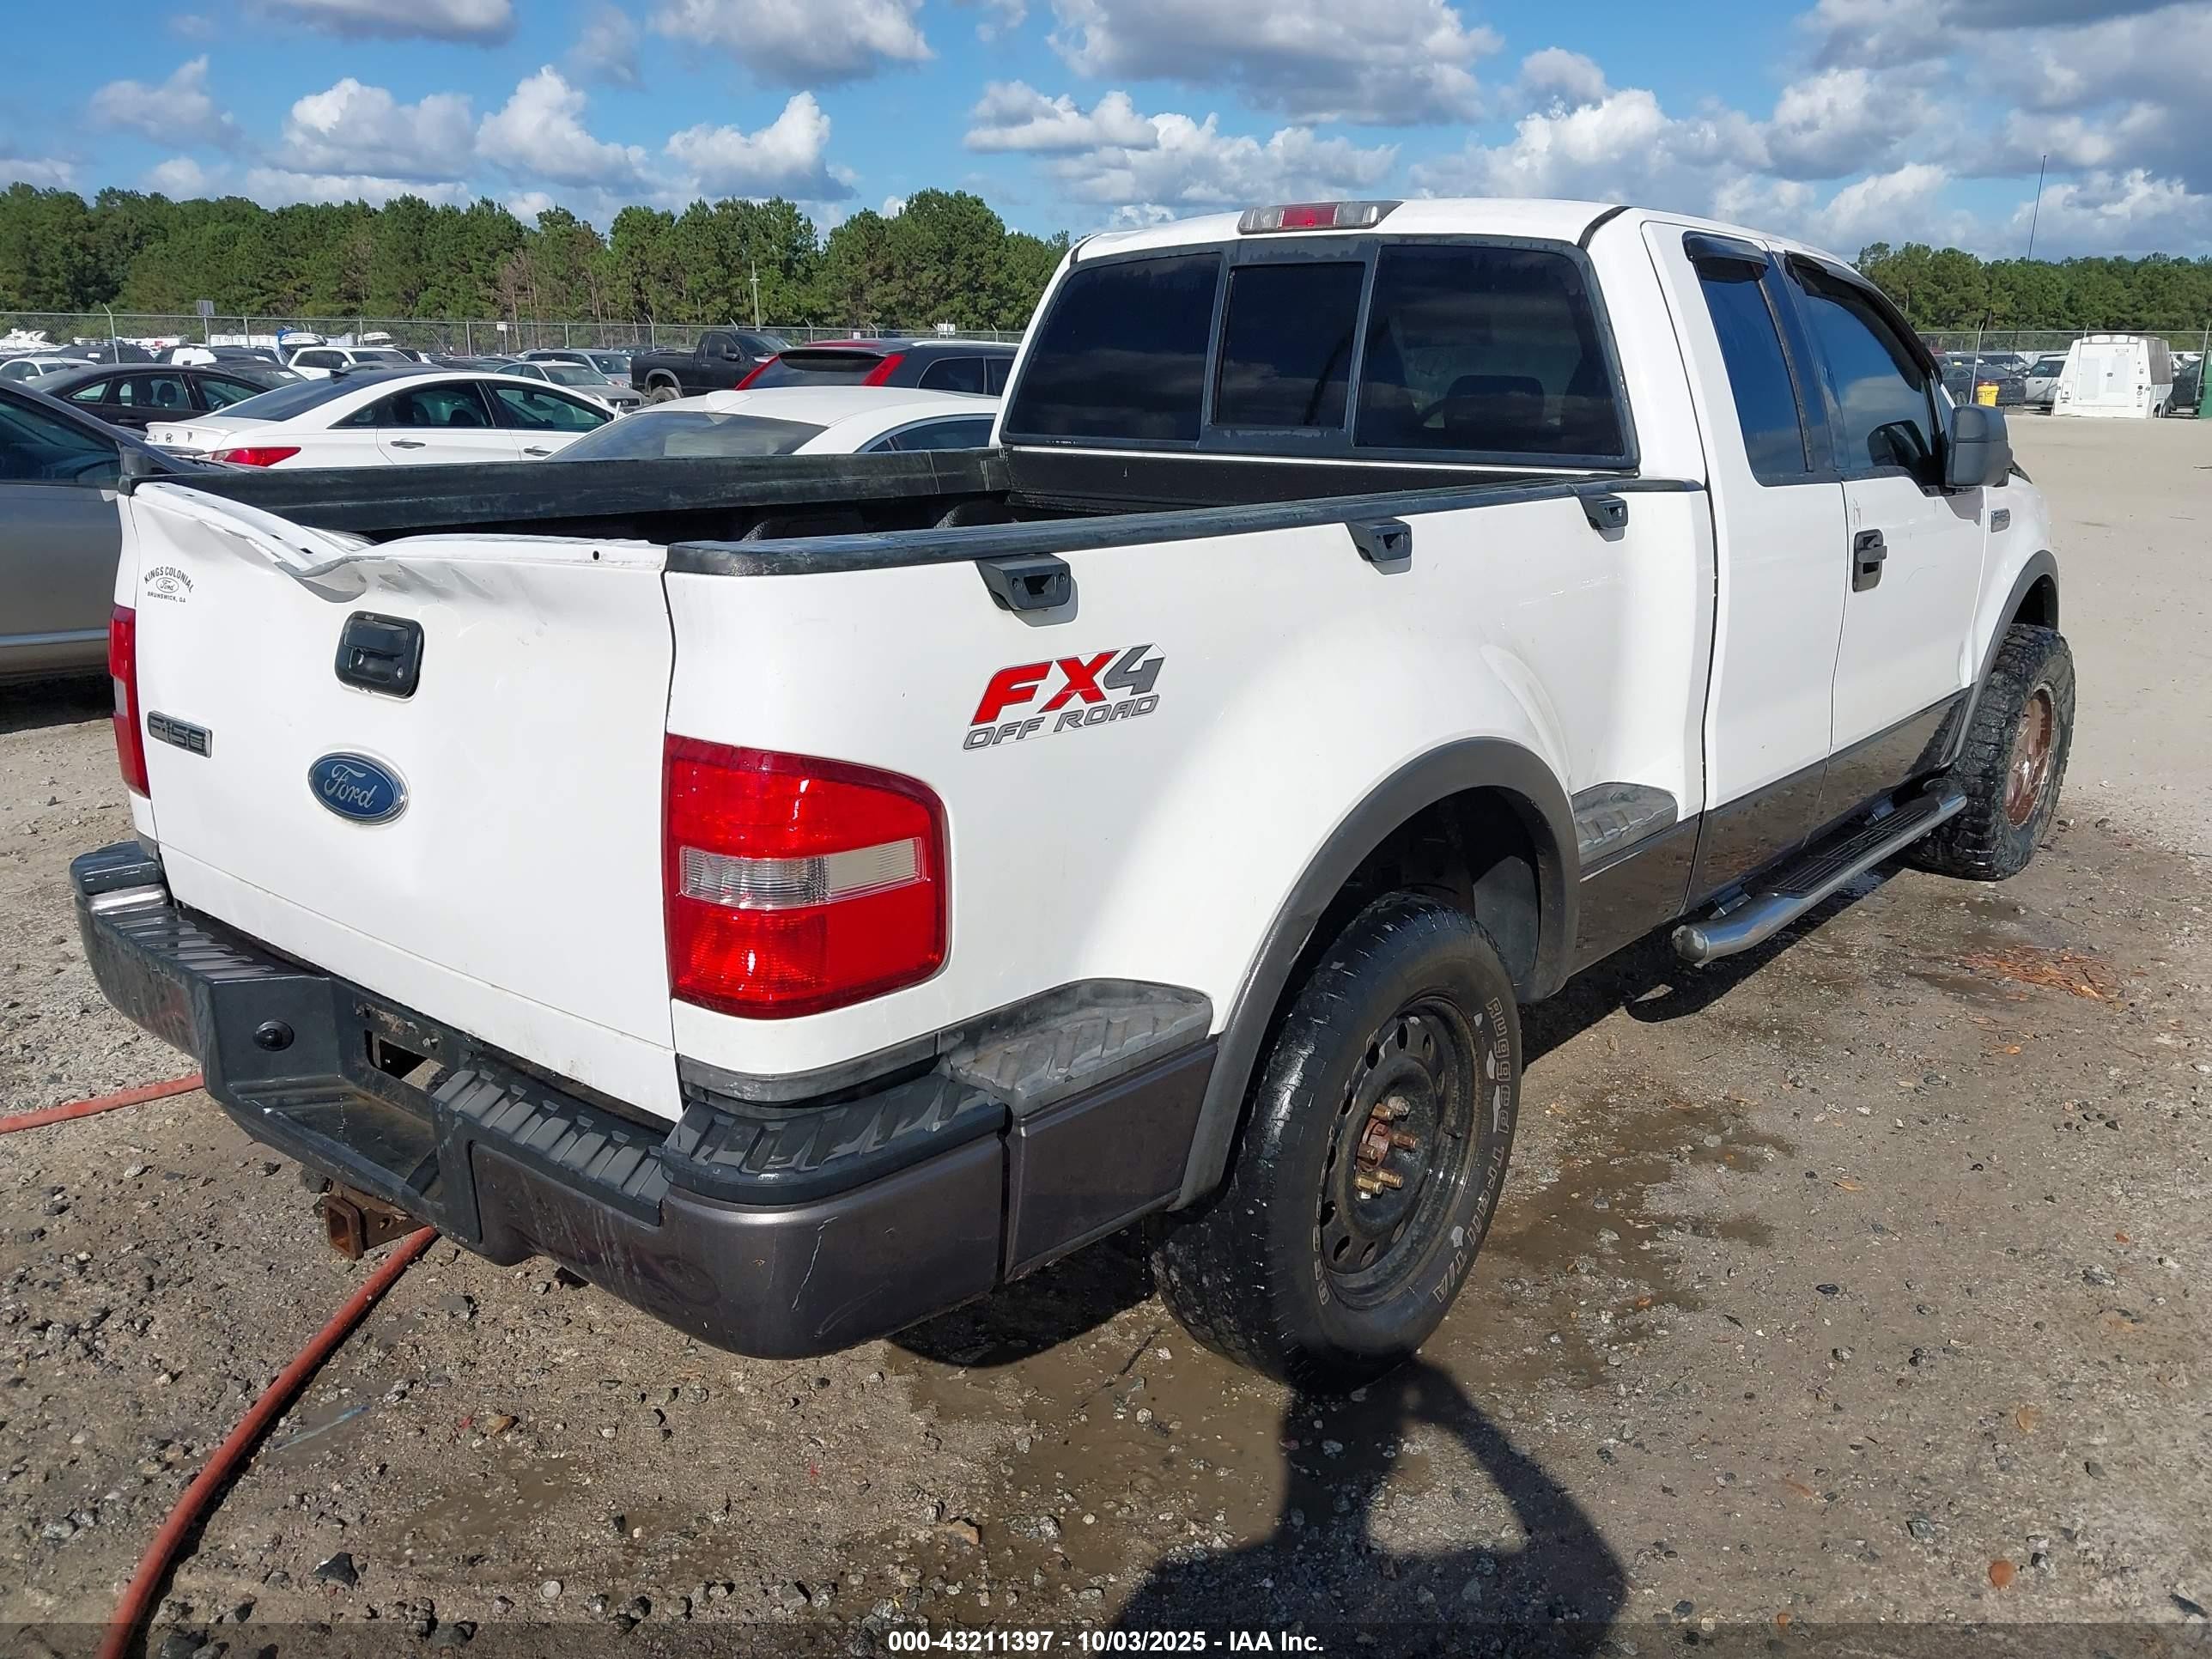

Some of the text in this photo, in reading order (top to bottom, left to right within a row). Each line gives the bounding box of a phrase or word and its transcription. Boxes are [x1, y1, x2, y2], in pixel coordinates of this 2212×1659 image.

[144, 566, 194, 593] KINGS COLONIAL
[970, 643, 1165, 726] FX4
[963, 695, 1160, 750] OFF ROAD
[325, 764, 377, 808] Ford
[1486, 997, 1511, 1134] Rugged
